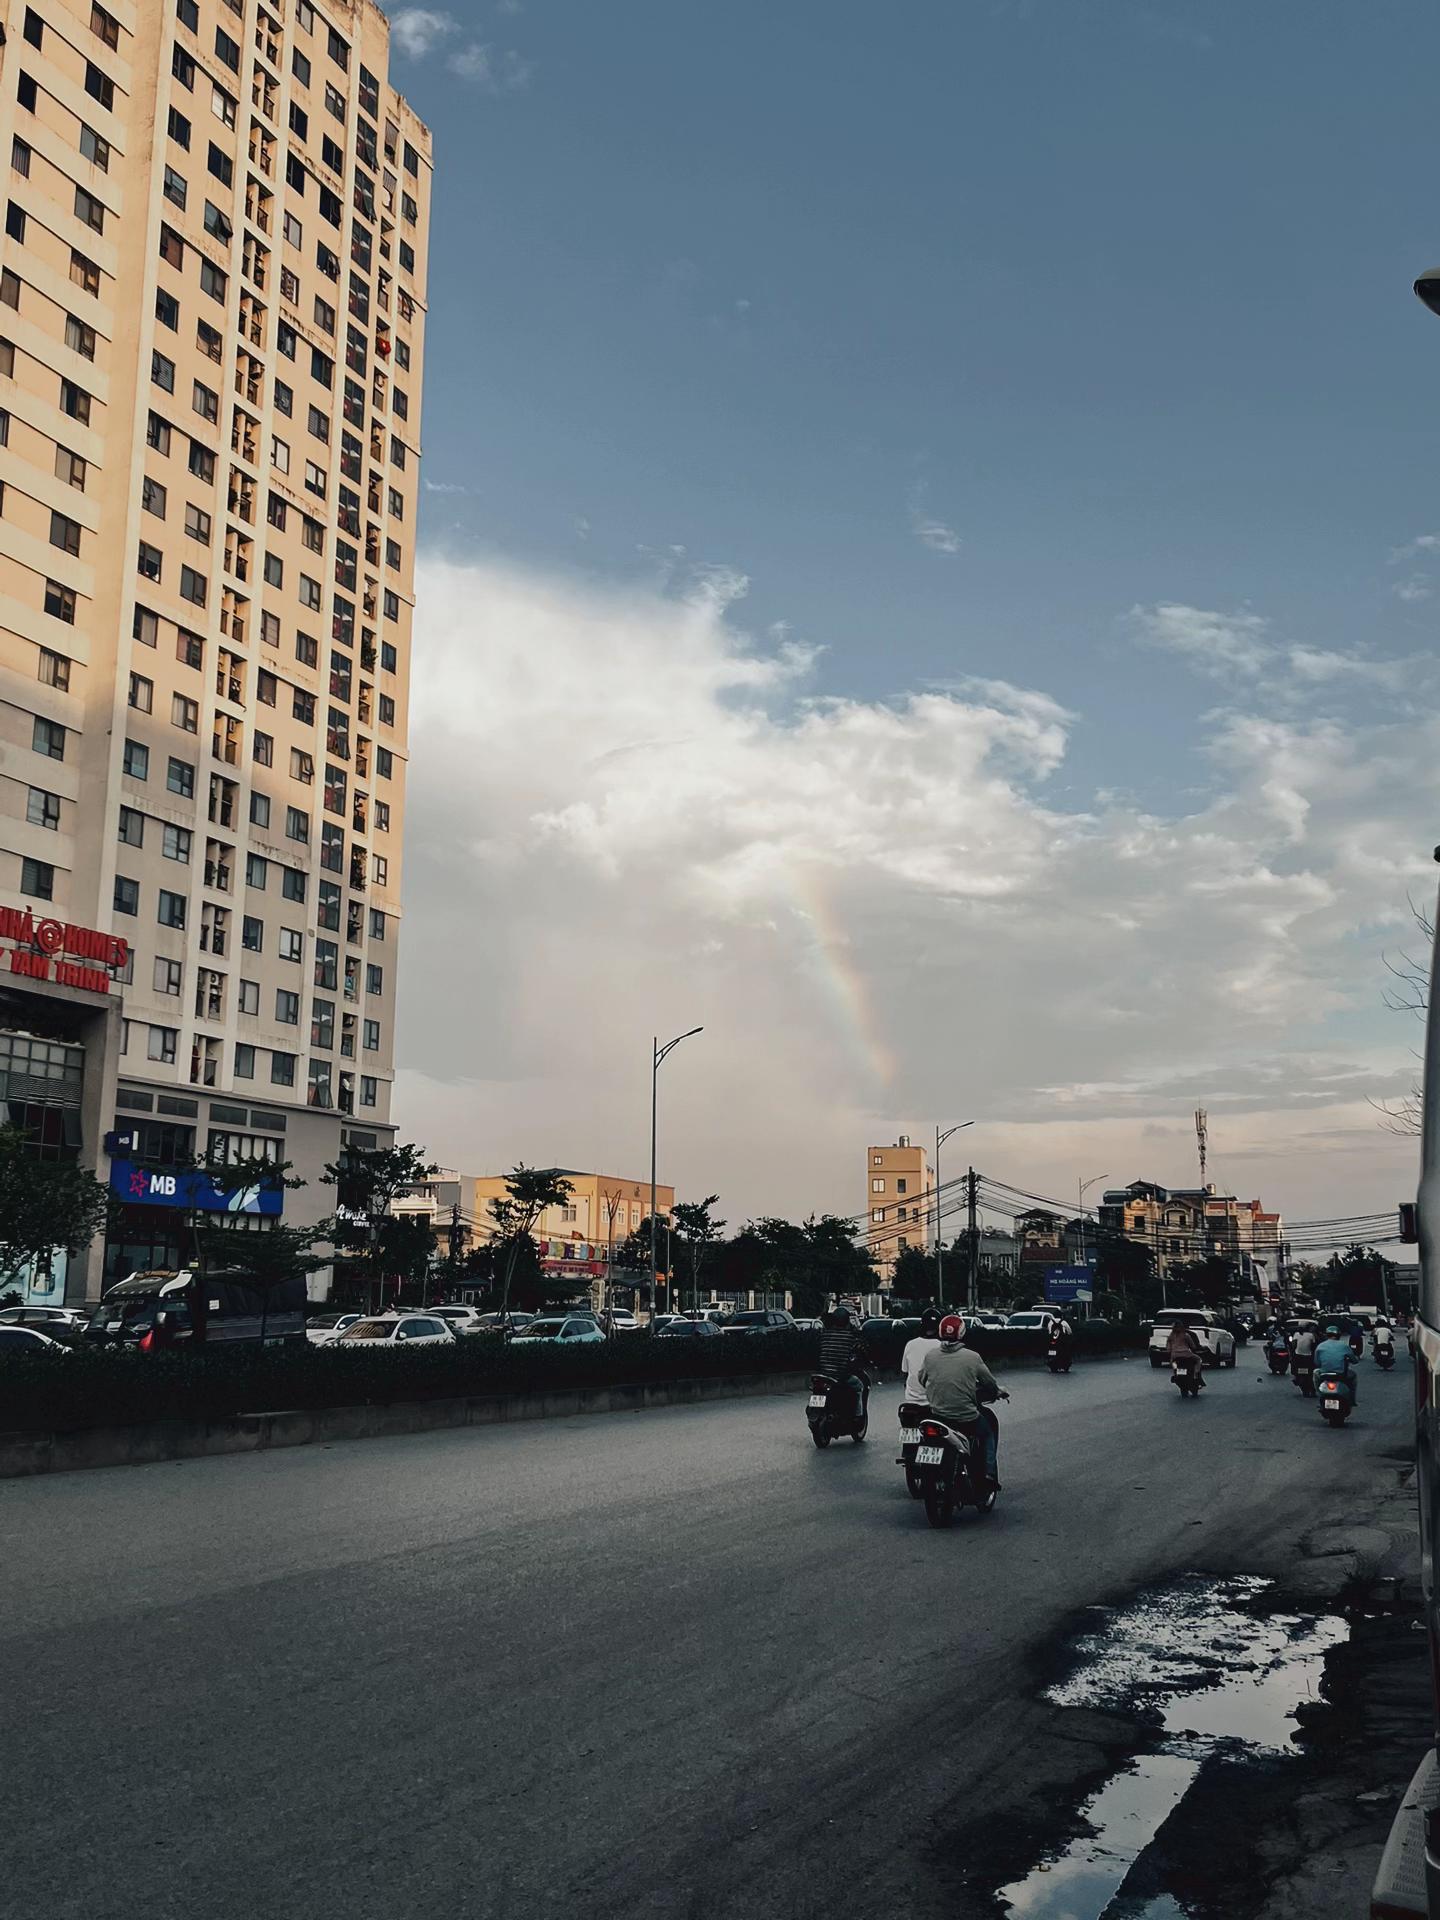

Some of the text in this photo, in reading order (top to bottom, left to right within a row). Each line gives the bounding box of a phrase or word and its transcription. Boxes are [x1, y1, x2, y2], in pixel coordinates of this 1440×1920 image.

[10, 949, 110, 993] TAM TRINH
[149, 1174, 176, 1196] MB
